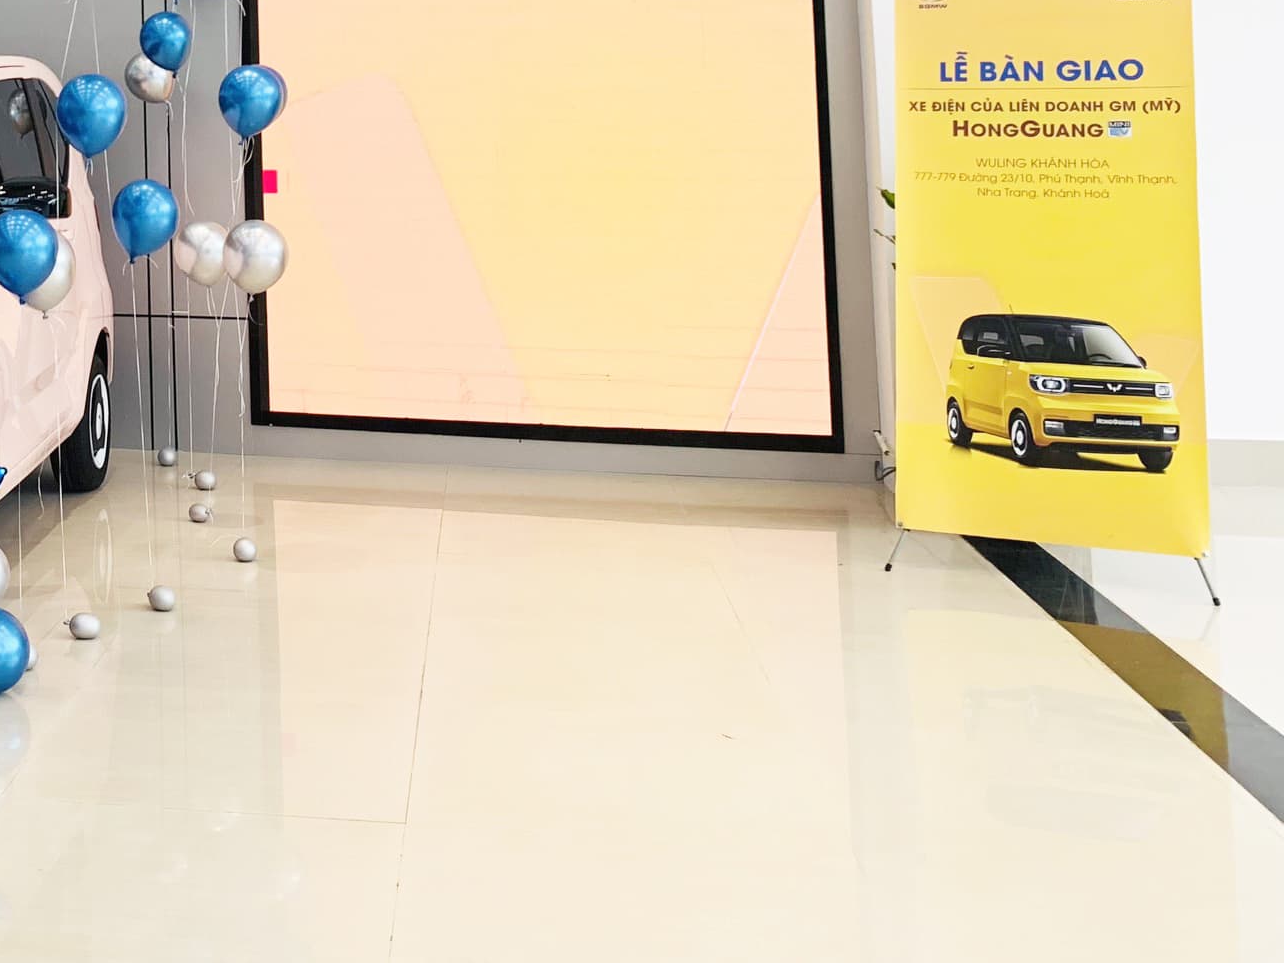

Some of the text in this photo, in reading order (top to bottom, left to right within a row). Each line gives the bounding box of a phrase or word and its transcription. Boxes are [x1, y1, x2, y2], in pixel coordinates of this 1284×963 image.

[940, 52, 1144, 82] LỄ BÀN GIAO
[909, 97, 1181, 115] XE ĐIỆN CỦA LIÊN DOANH GM (MỸ)
[976, 158, 1027, 169] WULING
[1030, 156, 1078, 169] KHÁNH
[977, 187, 1001, 198] Nha
[1042, 187, 1081, 199] Khánh
